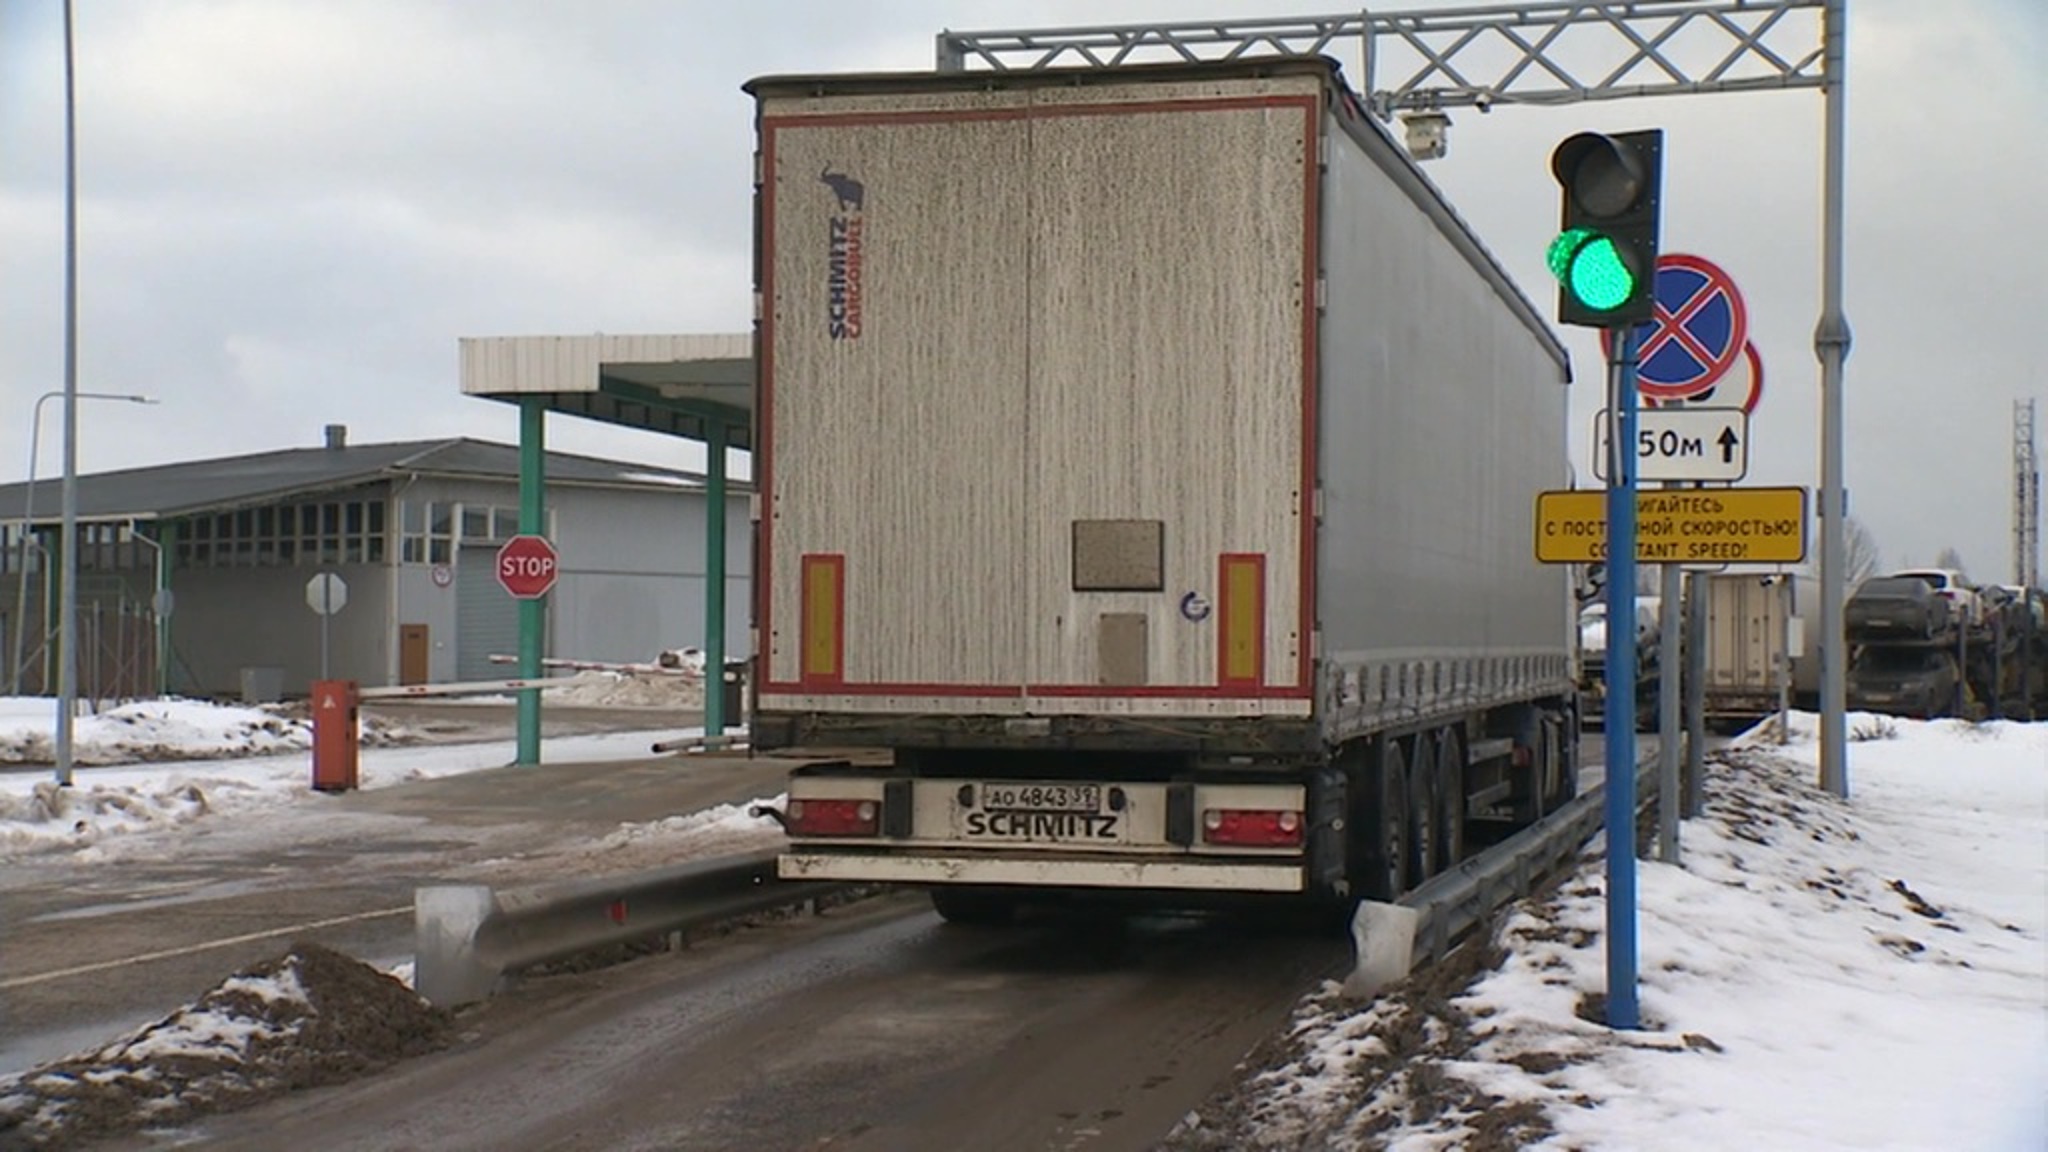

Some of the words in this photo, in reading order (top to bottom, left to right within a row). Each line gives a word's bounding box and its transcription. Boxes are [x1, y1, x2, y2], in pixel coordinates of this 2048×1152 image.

[829, 217, 847, 340] SCHMITZ
[847, 217, 863, 339] CARGOBULL
[1637, 495, 1724, 513] ИГАЙТЕСЬ
[1545, 521, 1556, 536] С
[1563, 517, 1674, 536] ПОСТНОЙ
[1681, 519, 1798, 536] СКОРОСТЬЮ!
[1589, 543, 1679, 557] COTANT
[1688, 542, 1748, 558] SPEED!
[502, 556, 553, 577] STOP
[1019, 787, 1068, 807] 4843
[966, 812, 1118, 838] SCHMITZ
